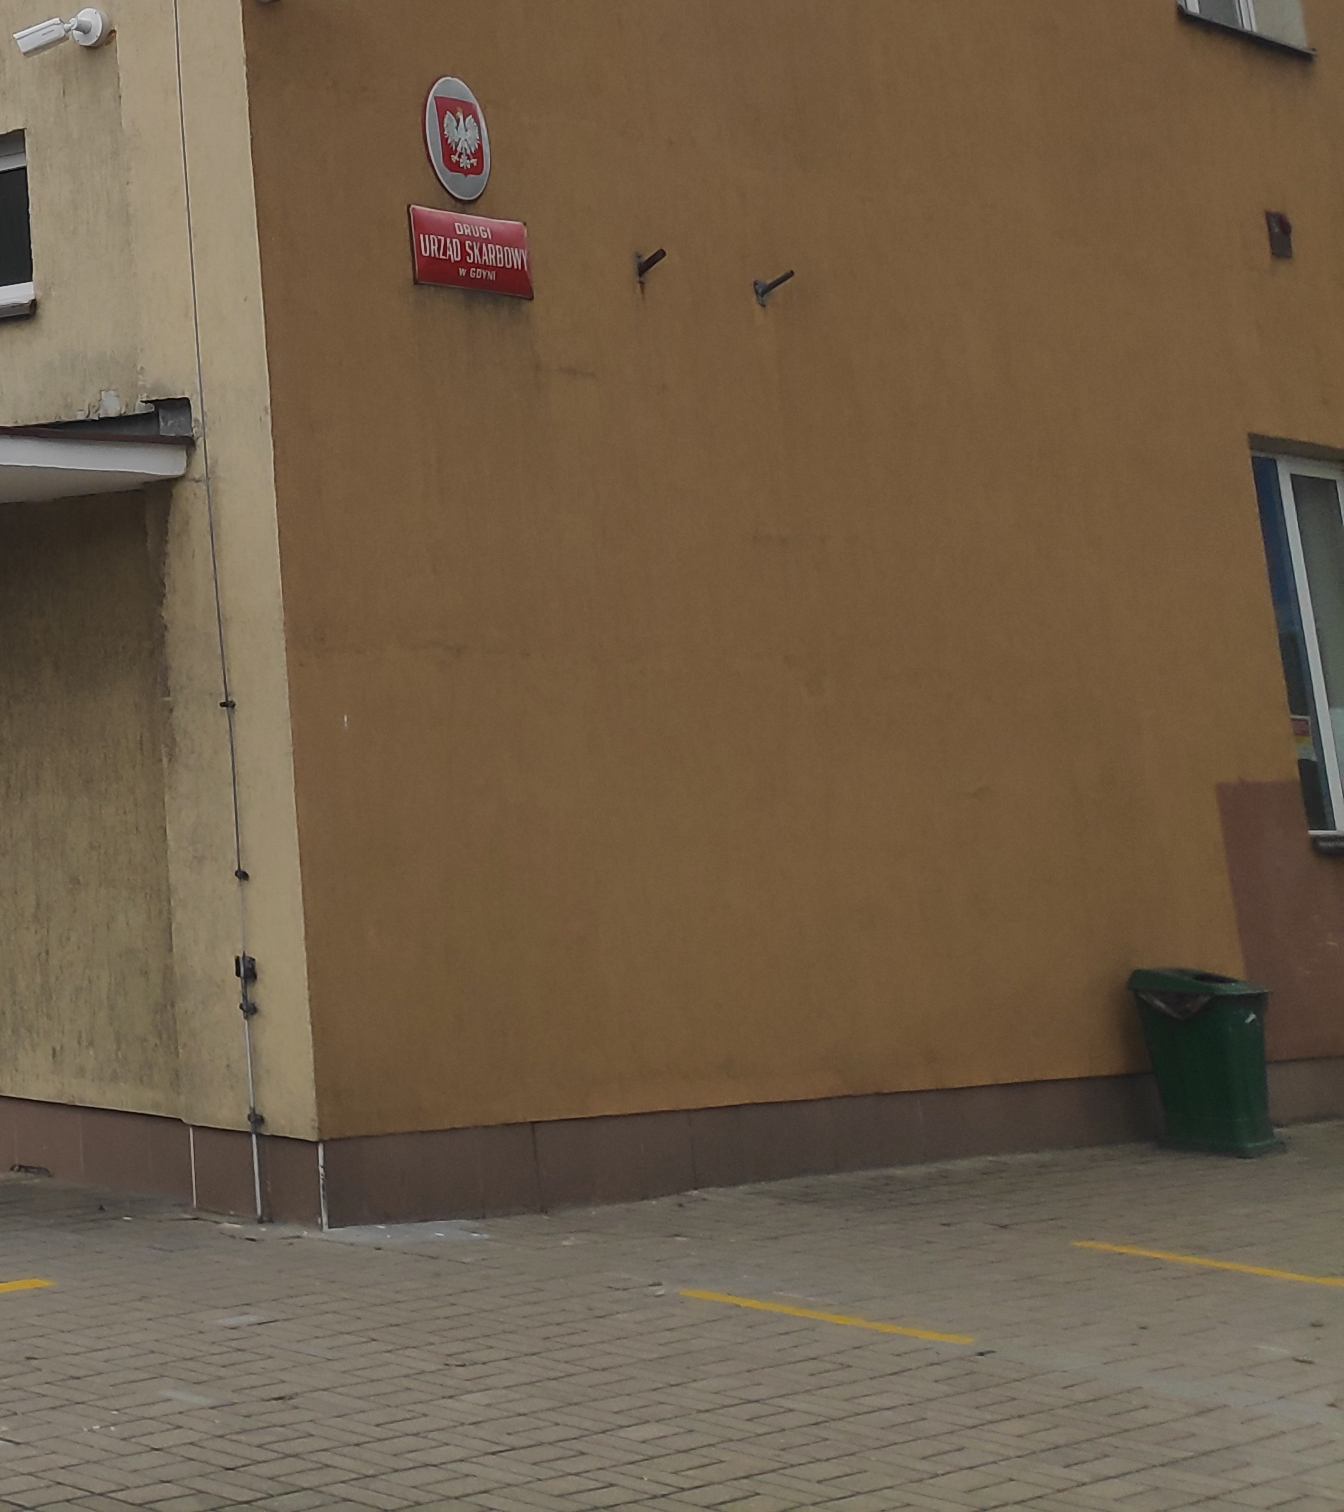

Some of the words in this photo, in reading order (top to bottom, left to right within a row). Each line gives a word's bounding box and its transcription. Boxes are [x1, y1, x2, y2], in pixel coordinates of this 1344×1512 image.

[454, 222, 492, 240] DRUGI
[419, 233, 462, 263] URZĄD
[465, 239, 528, 272] SKARBOWY
[458, 268, 467, 277] w
[469, 267, 496, 282] GDYNI
